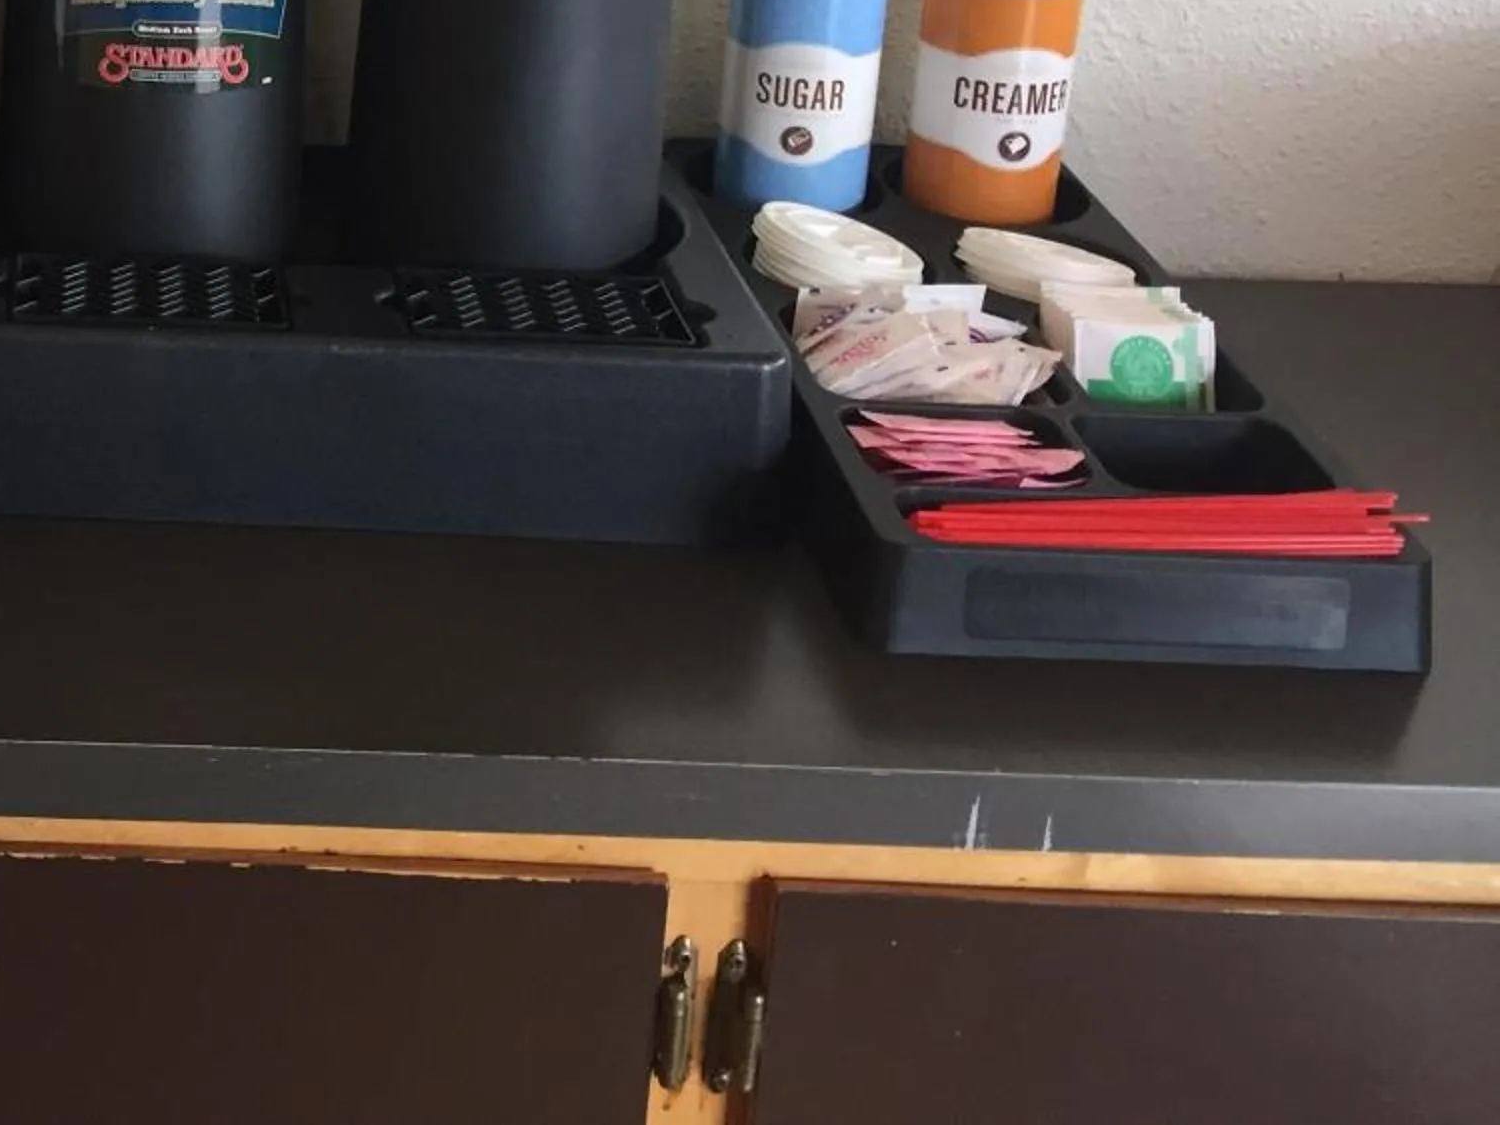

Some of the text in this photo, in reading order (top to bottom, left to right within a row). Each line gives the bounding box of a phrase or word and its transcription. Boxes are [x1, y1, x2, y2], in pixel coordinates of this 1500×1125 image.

[98, 42, 250, 85] STANDARD
[756, 72, 845, 111] SUGAR
[953, 75, 1068, 116] CREAMER
